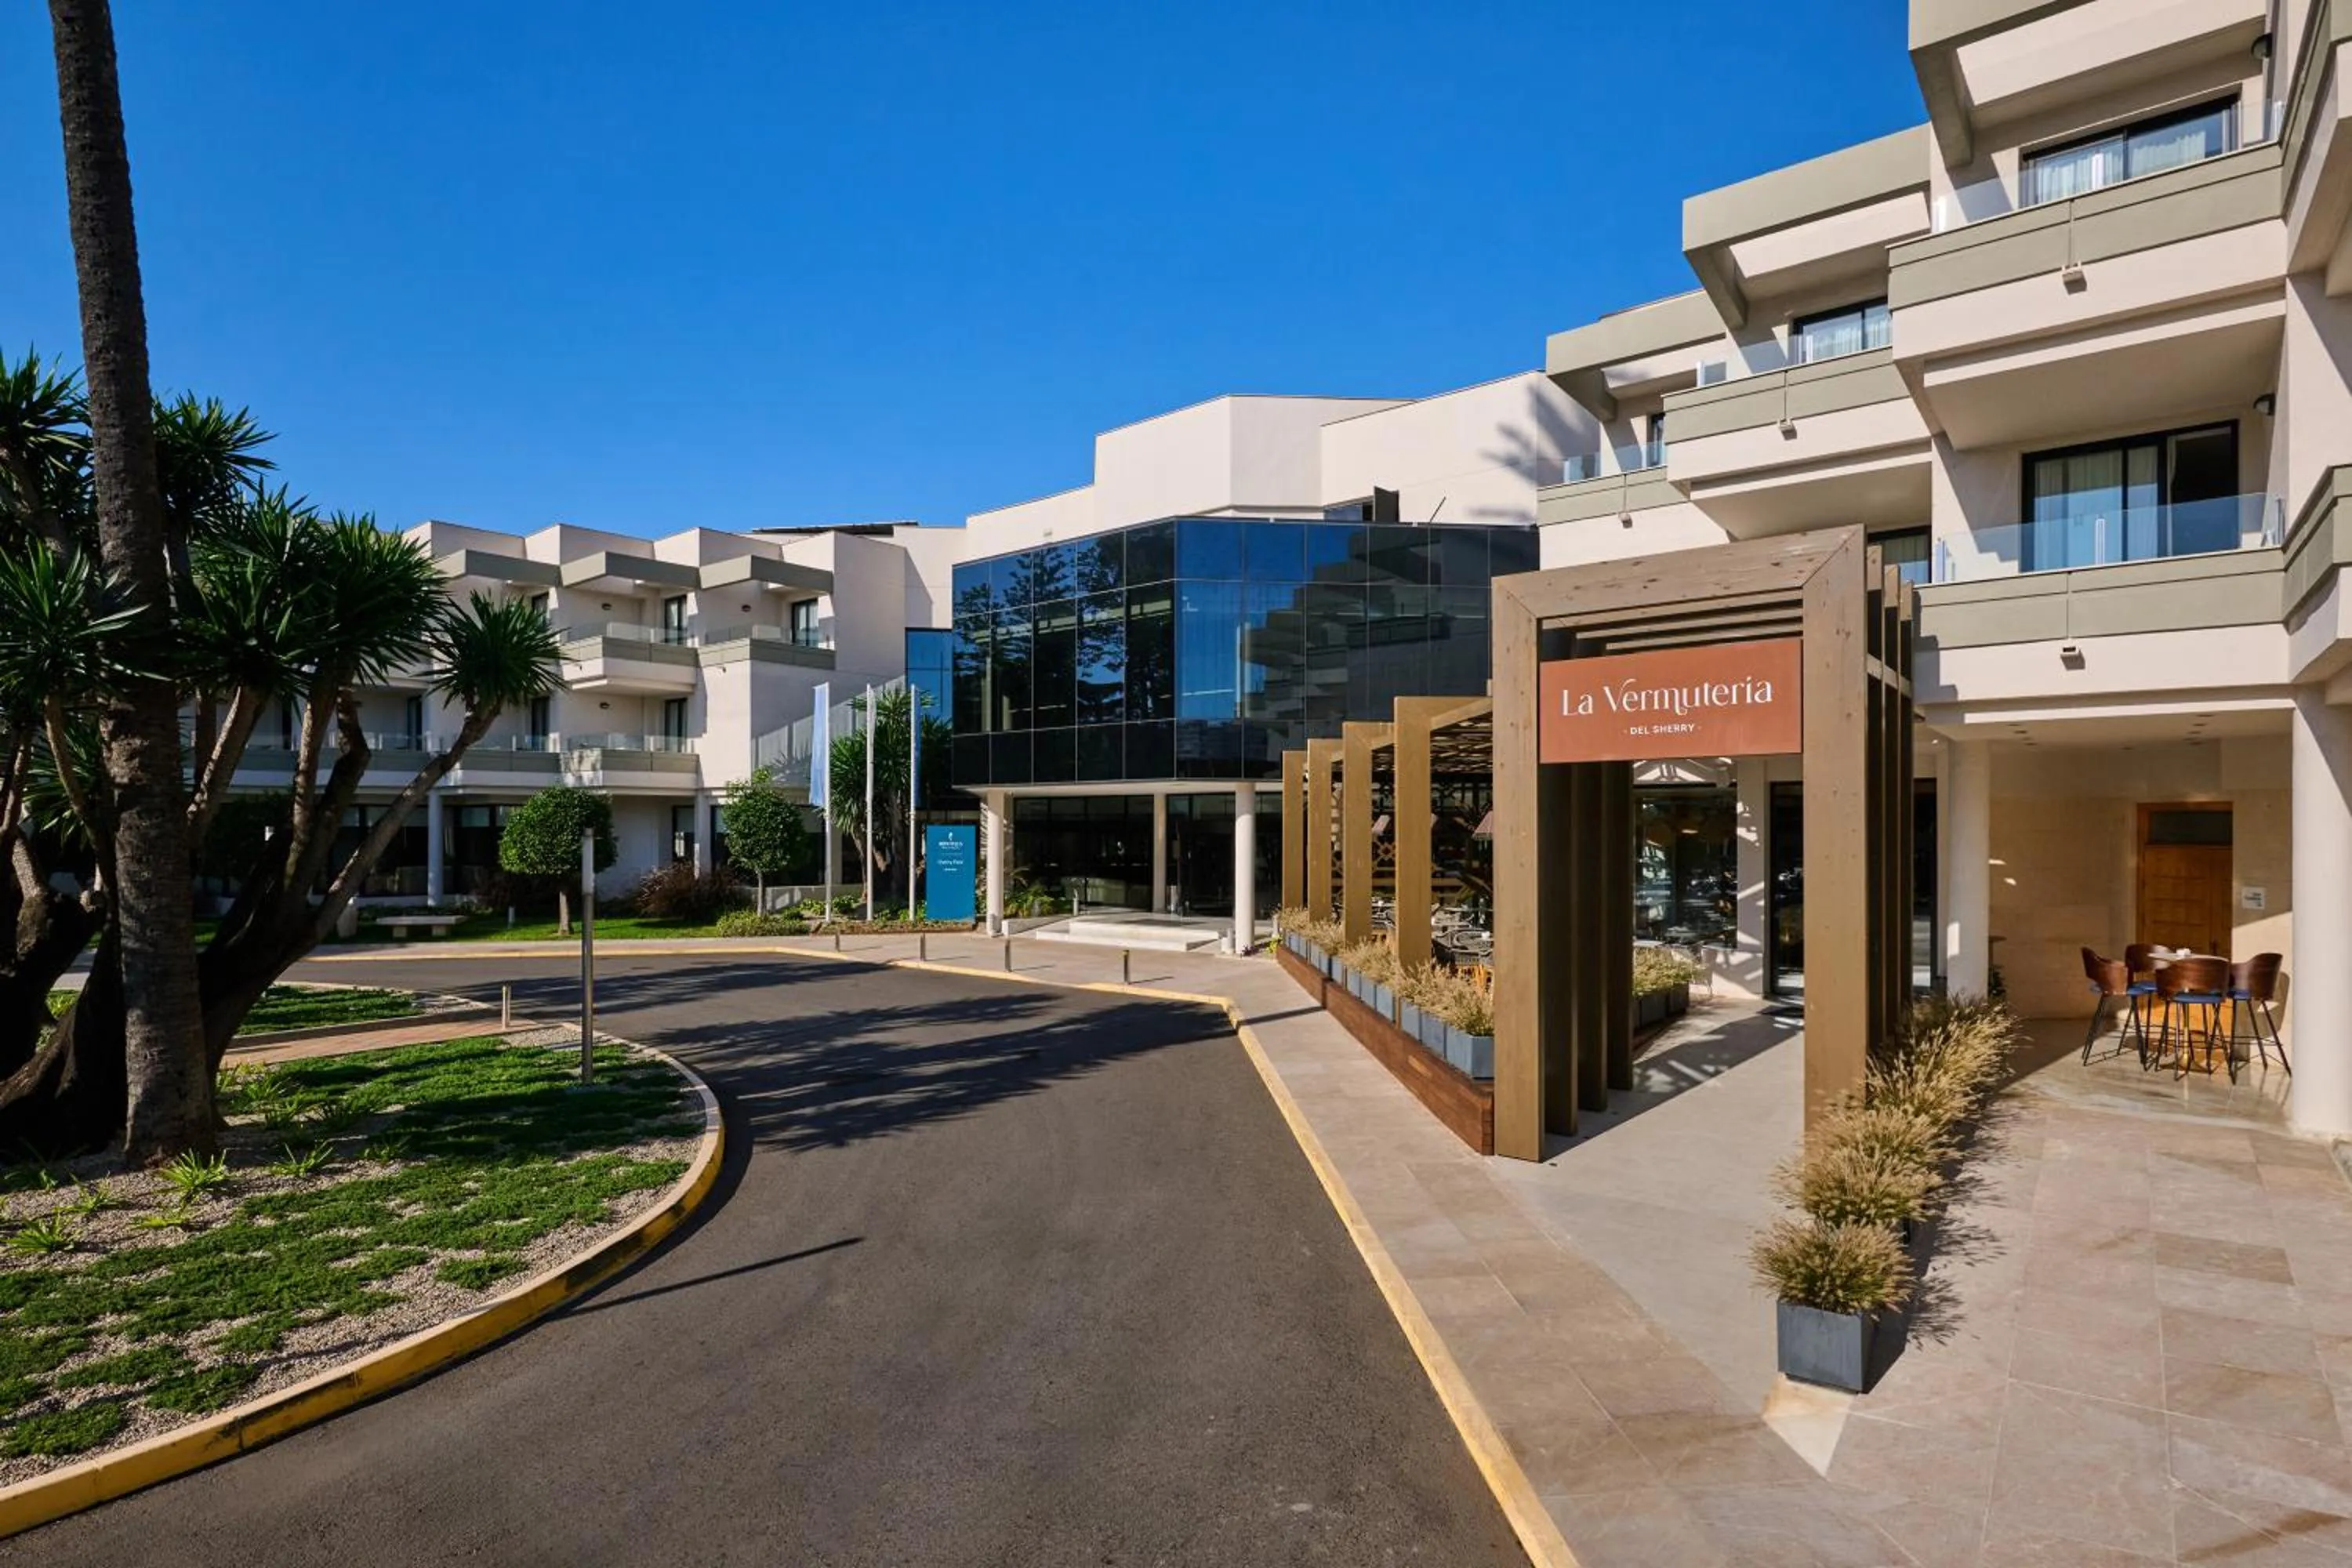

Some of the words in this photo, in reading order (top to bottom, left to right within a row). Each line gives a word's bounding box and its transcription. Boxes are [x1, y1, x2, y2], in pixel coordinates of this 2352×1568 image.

[1562, 688, 1594, 716] La
[1630, 726, 1650, 735] DEL
[1652, 724, 1695, 734] SHERRY
